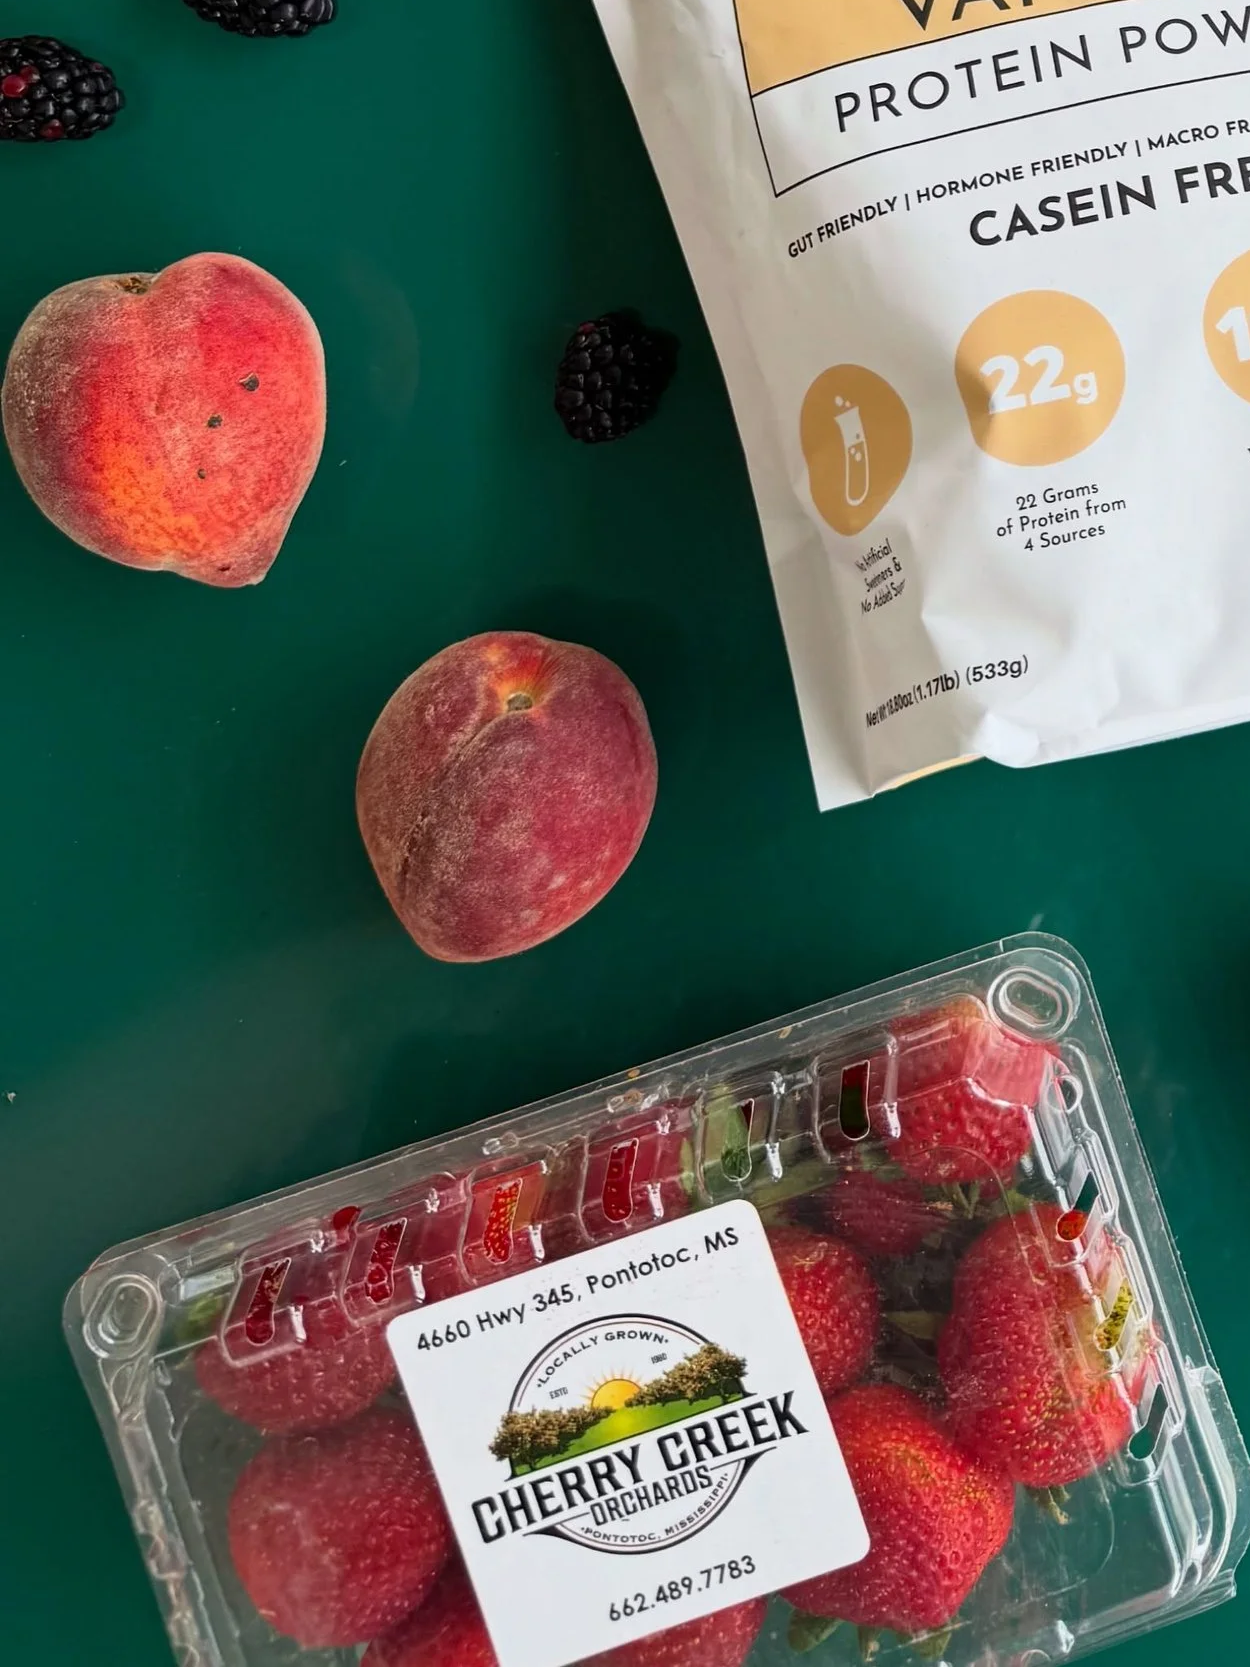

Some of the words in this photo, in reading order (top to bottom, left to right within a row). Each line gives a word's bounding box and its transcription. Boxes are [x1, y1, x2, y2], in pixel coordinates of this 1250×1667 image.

[835, 35, 1092, 133] PROTEIN
[788, 233, 813, 258] GUT
[817, 196, 898, 243] FRIENDLY
[916, 166, 1024, 204] HORMONE
[1031, 142, 1128, 176] FRIENDLY
[1148, 125, 1220, 151] MACRO
[969, 174, 1157, 246] CASEIN
[980, 345, 1099, 415] 22g
[996, 518, 1014, 537] of
[1019, 507, 1080, 532] Protein
[1085, 499, 1127, 516] from
[1016, 494, 1038, 511] 22
[1043, 483, 1099, 504] Grams
[1024, 537, 1034, 551] 4
[1040, 524, 1106, 549] Sources
[913, 670, 960, 704] (1.17lb)
[966, 654, 1029, 686] (533g)
[416, 1319, 472, 1353] 4660
[475, 1302, 527, 1334] Hwy
[531, 1283, 582, 1315] 345,
[585, 1244, 700, 1295] Pontotoc,
[704, 1227, 740, 1254] MS
[539, 1335, 599, 1385] LOCALLY
[604, 1330, 665, 1344] GROWN
[549, 1386, 569, 1400] ESTD
[470, 1443, 643, 1544] CHERRY
[656, 1390, 809, 1473] CREEK
[589, 1464, 713, 1527] ORCHARDS
[584, 1526, 661, 1543] PONTOTOC,
[665, 1476, 728, 1537] MISSISSIPPI
[607, 1555, 757, 1623] 662.489.7783
